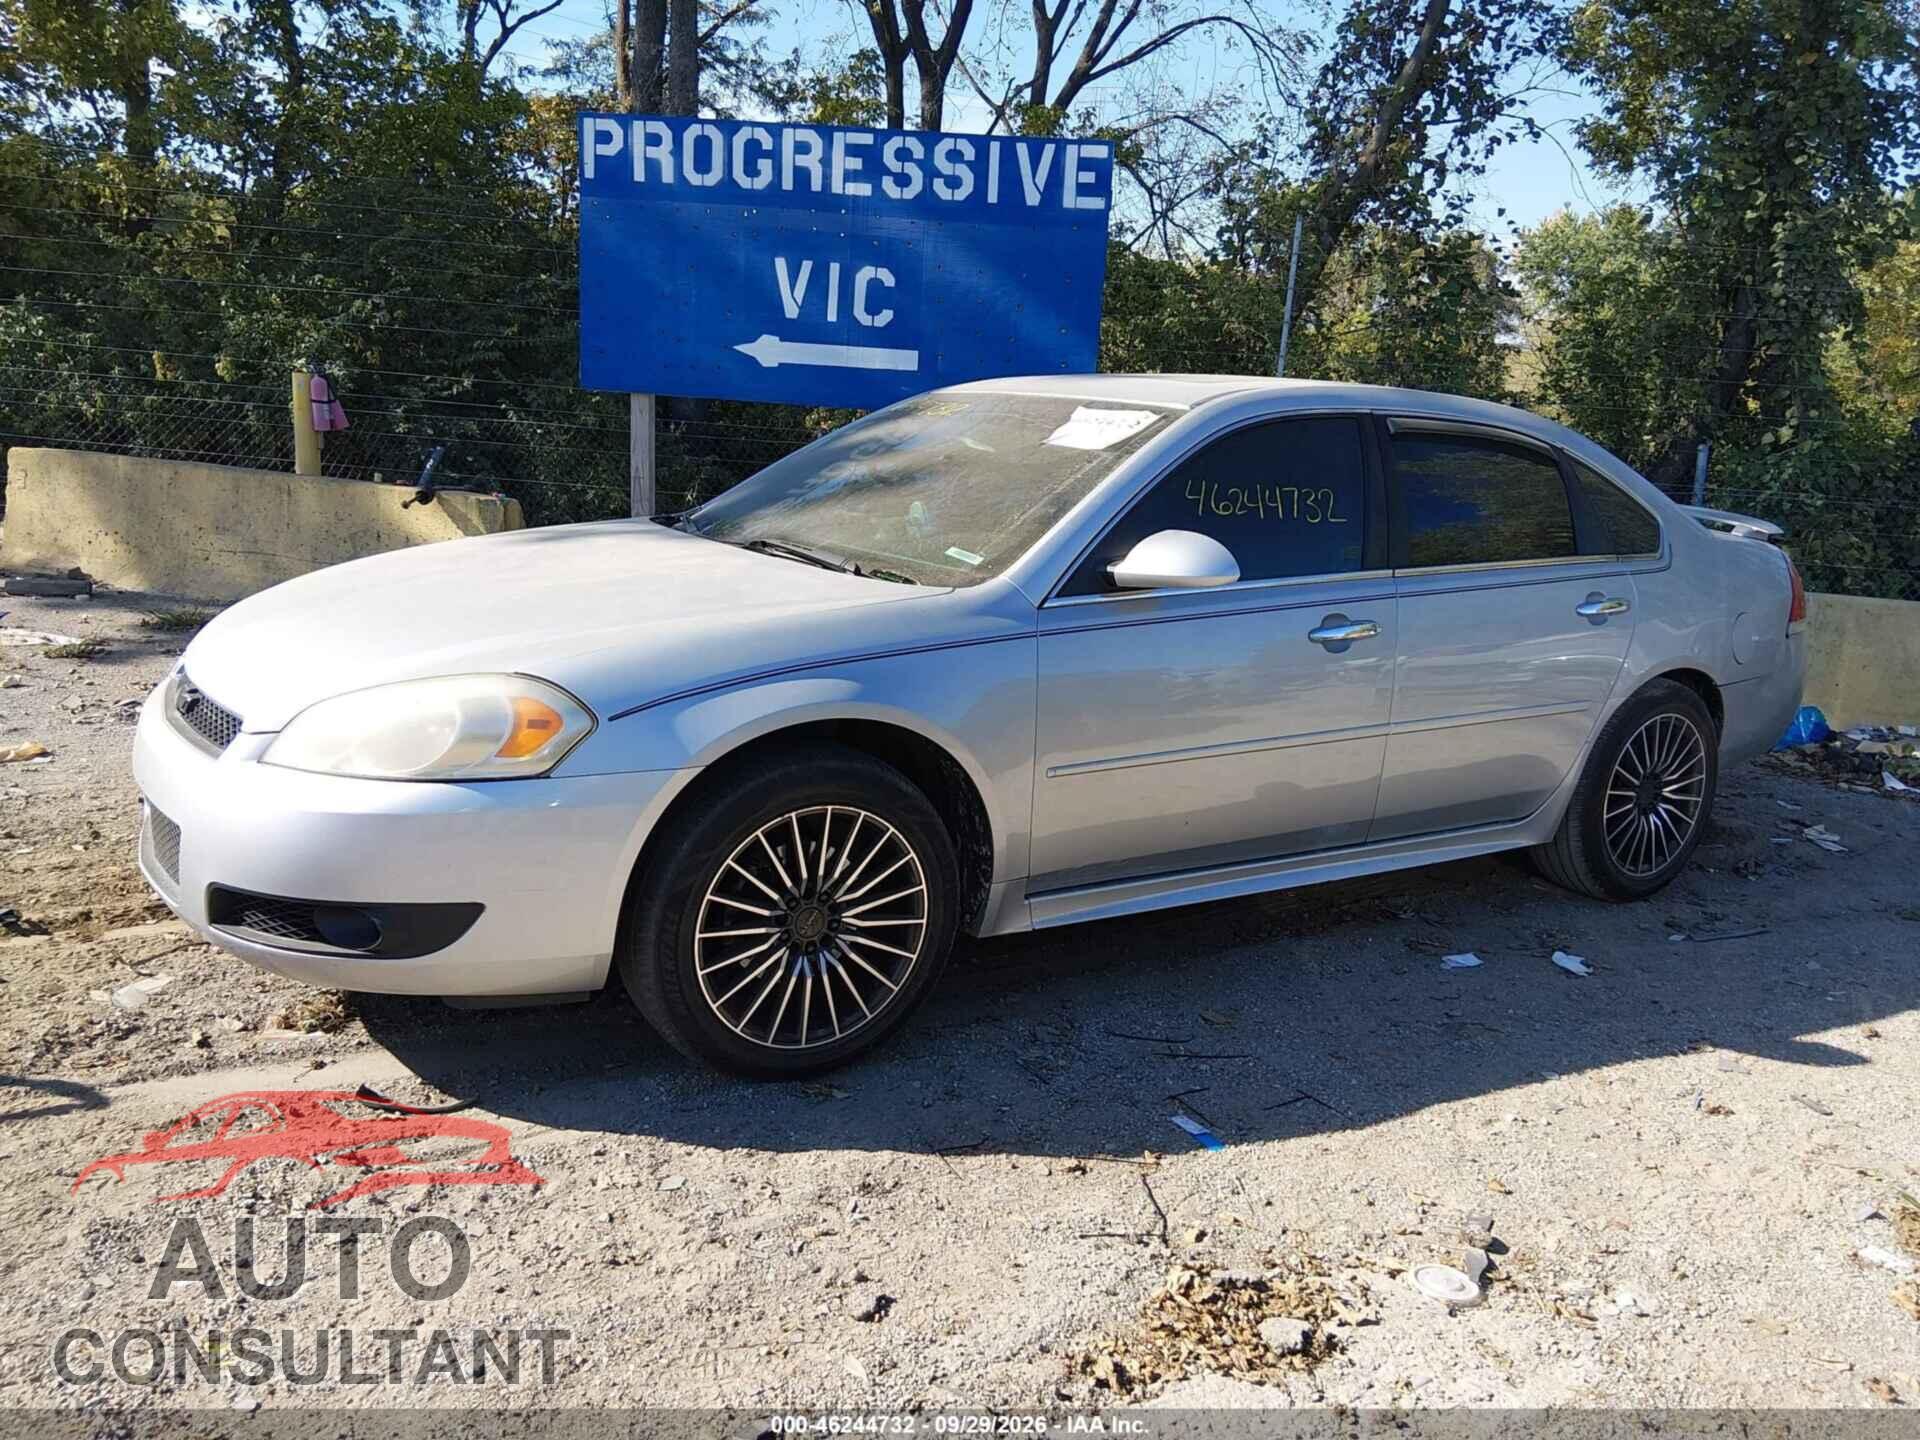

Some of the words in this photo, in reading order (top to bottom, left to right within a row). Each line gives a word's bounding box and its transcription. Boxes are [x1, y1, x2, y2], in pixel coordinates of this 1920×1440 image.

[583, 117, 1109, 209] PROGRESSIVE
[774, 257, 896, 327] VIC
[1185, 480, 1347, 523] 46244732
